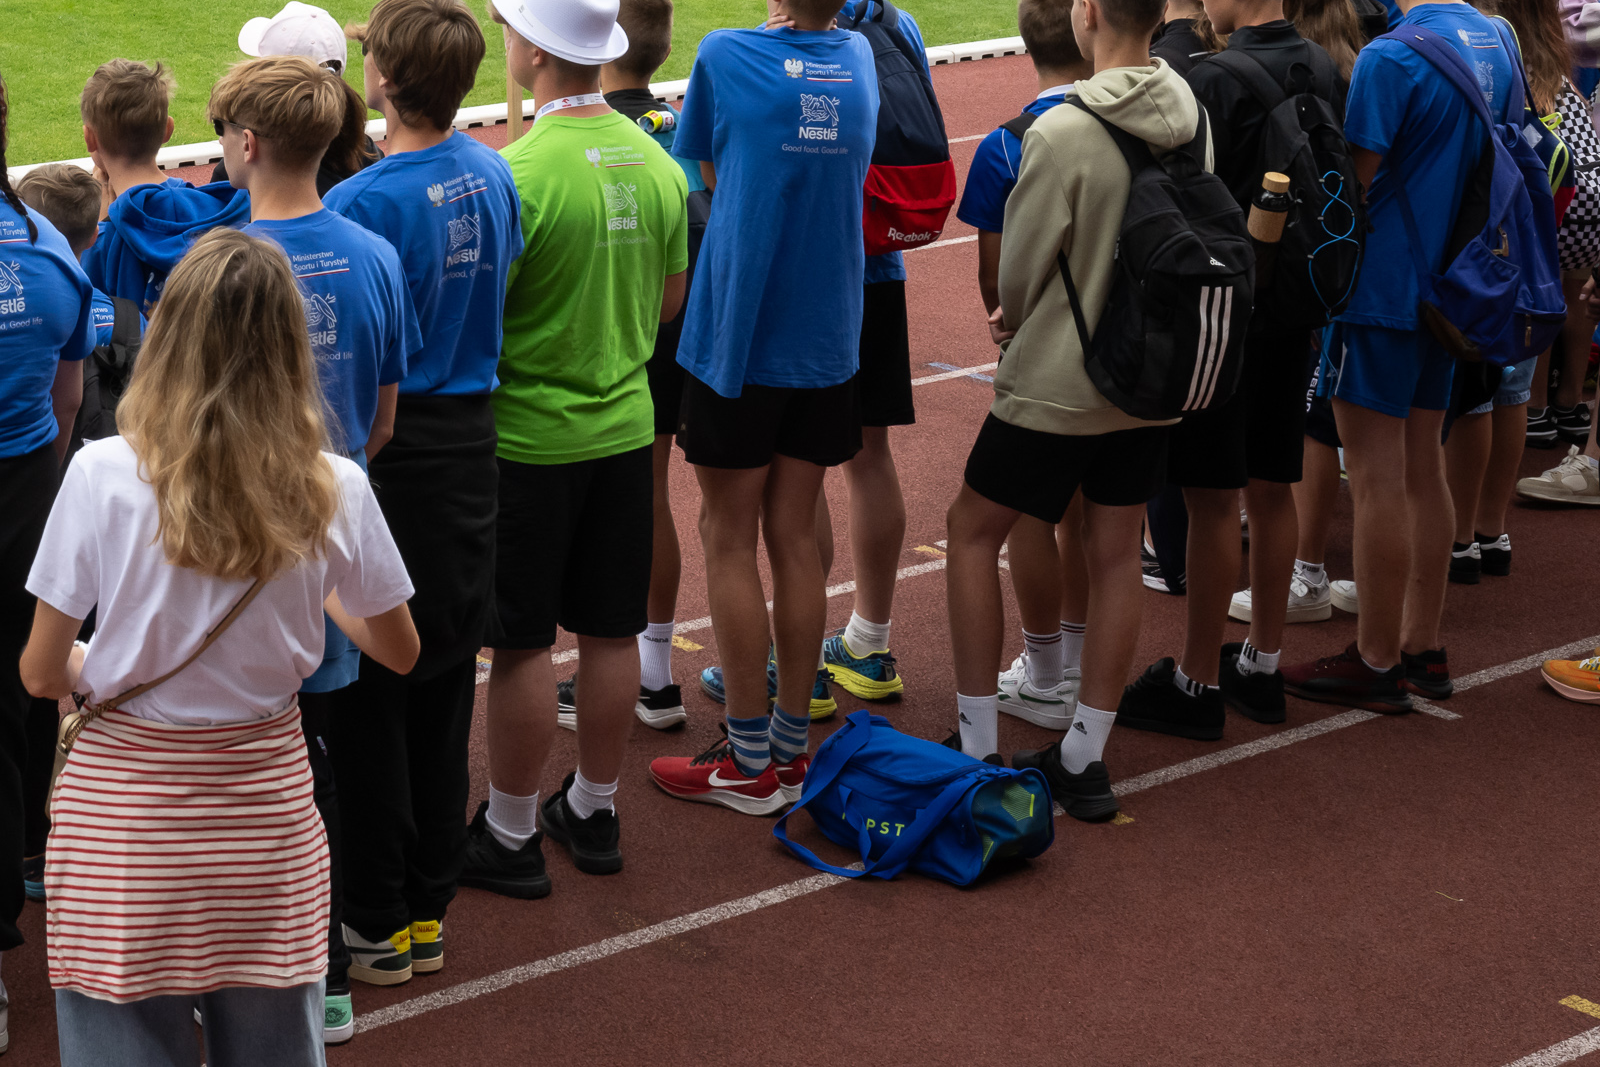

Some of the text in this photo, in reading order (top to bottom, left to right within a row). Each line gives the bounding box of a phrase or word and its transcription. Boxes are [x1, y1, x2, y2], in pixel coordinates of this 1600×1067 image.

[805, 61, 842, 69] Ministerstwo
[805, 68, 853, 78] Sportu Turystyki
[798, 126, 838, 141] Nestlé
[781, 143, 849, 155] Good food, Good life
[3, 227, 27, 236] Turystyki
[887, 226, 932, 243] Reebok
[292, 250, 334, 262] Ministerstwo
[293, 256, 349, 272] Sportu Turystyki
[481, 263, 494, 272] life
[9, 317, 31, 329] Good
[32, 316, 43, 326] life
